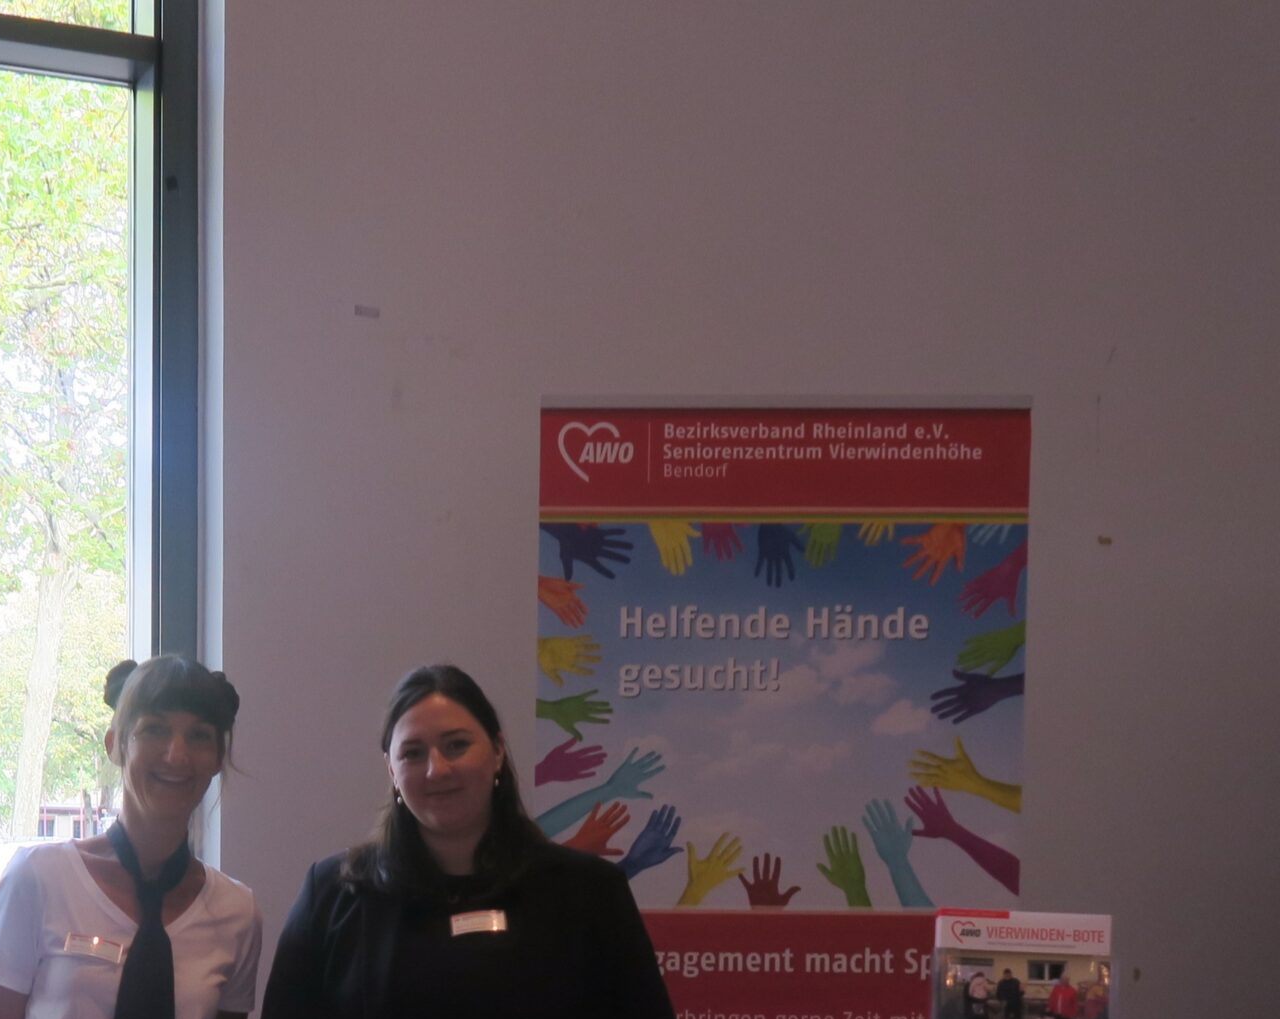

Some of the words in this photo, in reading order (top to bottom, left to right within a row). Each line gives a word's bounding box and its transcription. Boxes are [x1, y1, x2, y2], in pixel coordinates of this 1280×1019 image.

[663, 422, 806, 440] Bezirksverband
[812, 422, 908, 440] Rheinland
[914, 423, 950, 440] e.V.
[578, 440, 634, 464] AWO
[663, 442, 822, 460] Seniorenzentrum
[828, 443, 983, 461] Vierwindenhöhe
[663, 462, 729, 479] Bendorf
[620, 605, 791, 639] Helfende
[806, 603, 930, 640] Hände
[619, 656, 781, 697] gesucht!
[986, 926, 1105, 944] VIERWINDEN-BOTE
[805, 947, 895, 974] macht
